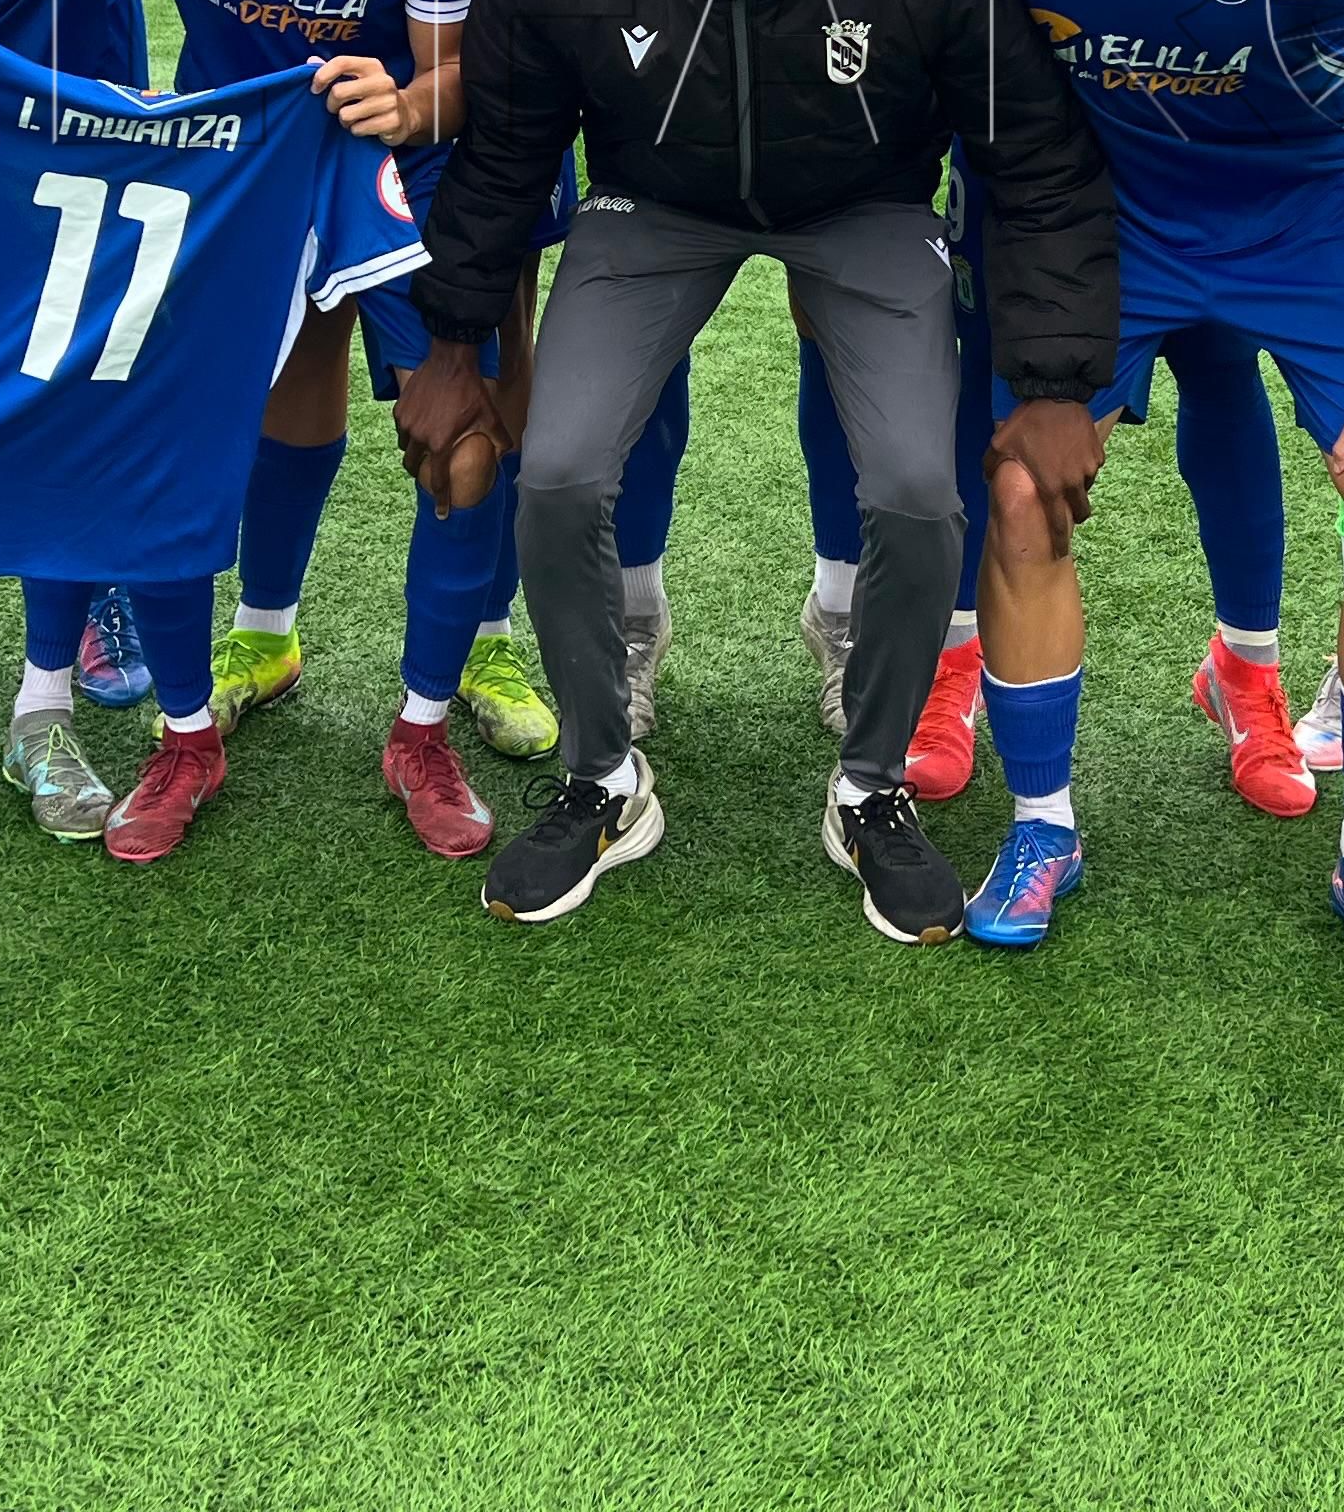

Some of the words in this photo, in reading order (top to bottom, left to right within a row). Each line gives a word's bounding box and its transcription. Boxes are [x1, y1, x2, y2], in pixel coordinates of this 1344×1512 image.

[239, 0, 362, 43] DEPORTE
[1102, 68, 1247, 97] DEPORTE
[59, 108, 241, 152] MWANZA
[20, 171, 190, 382] 11
